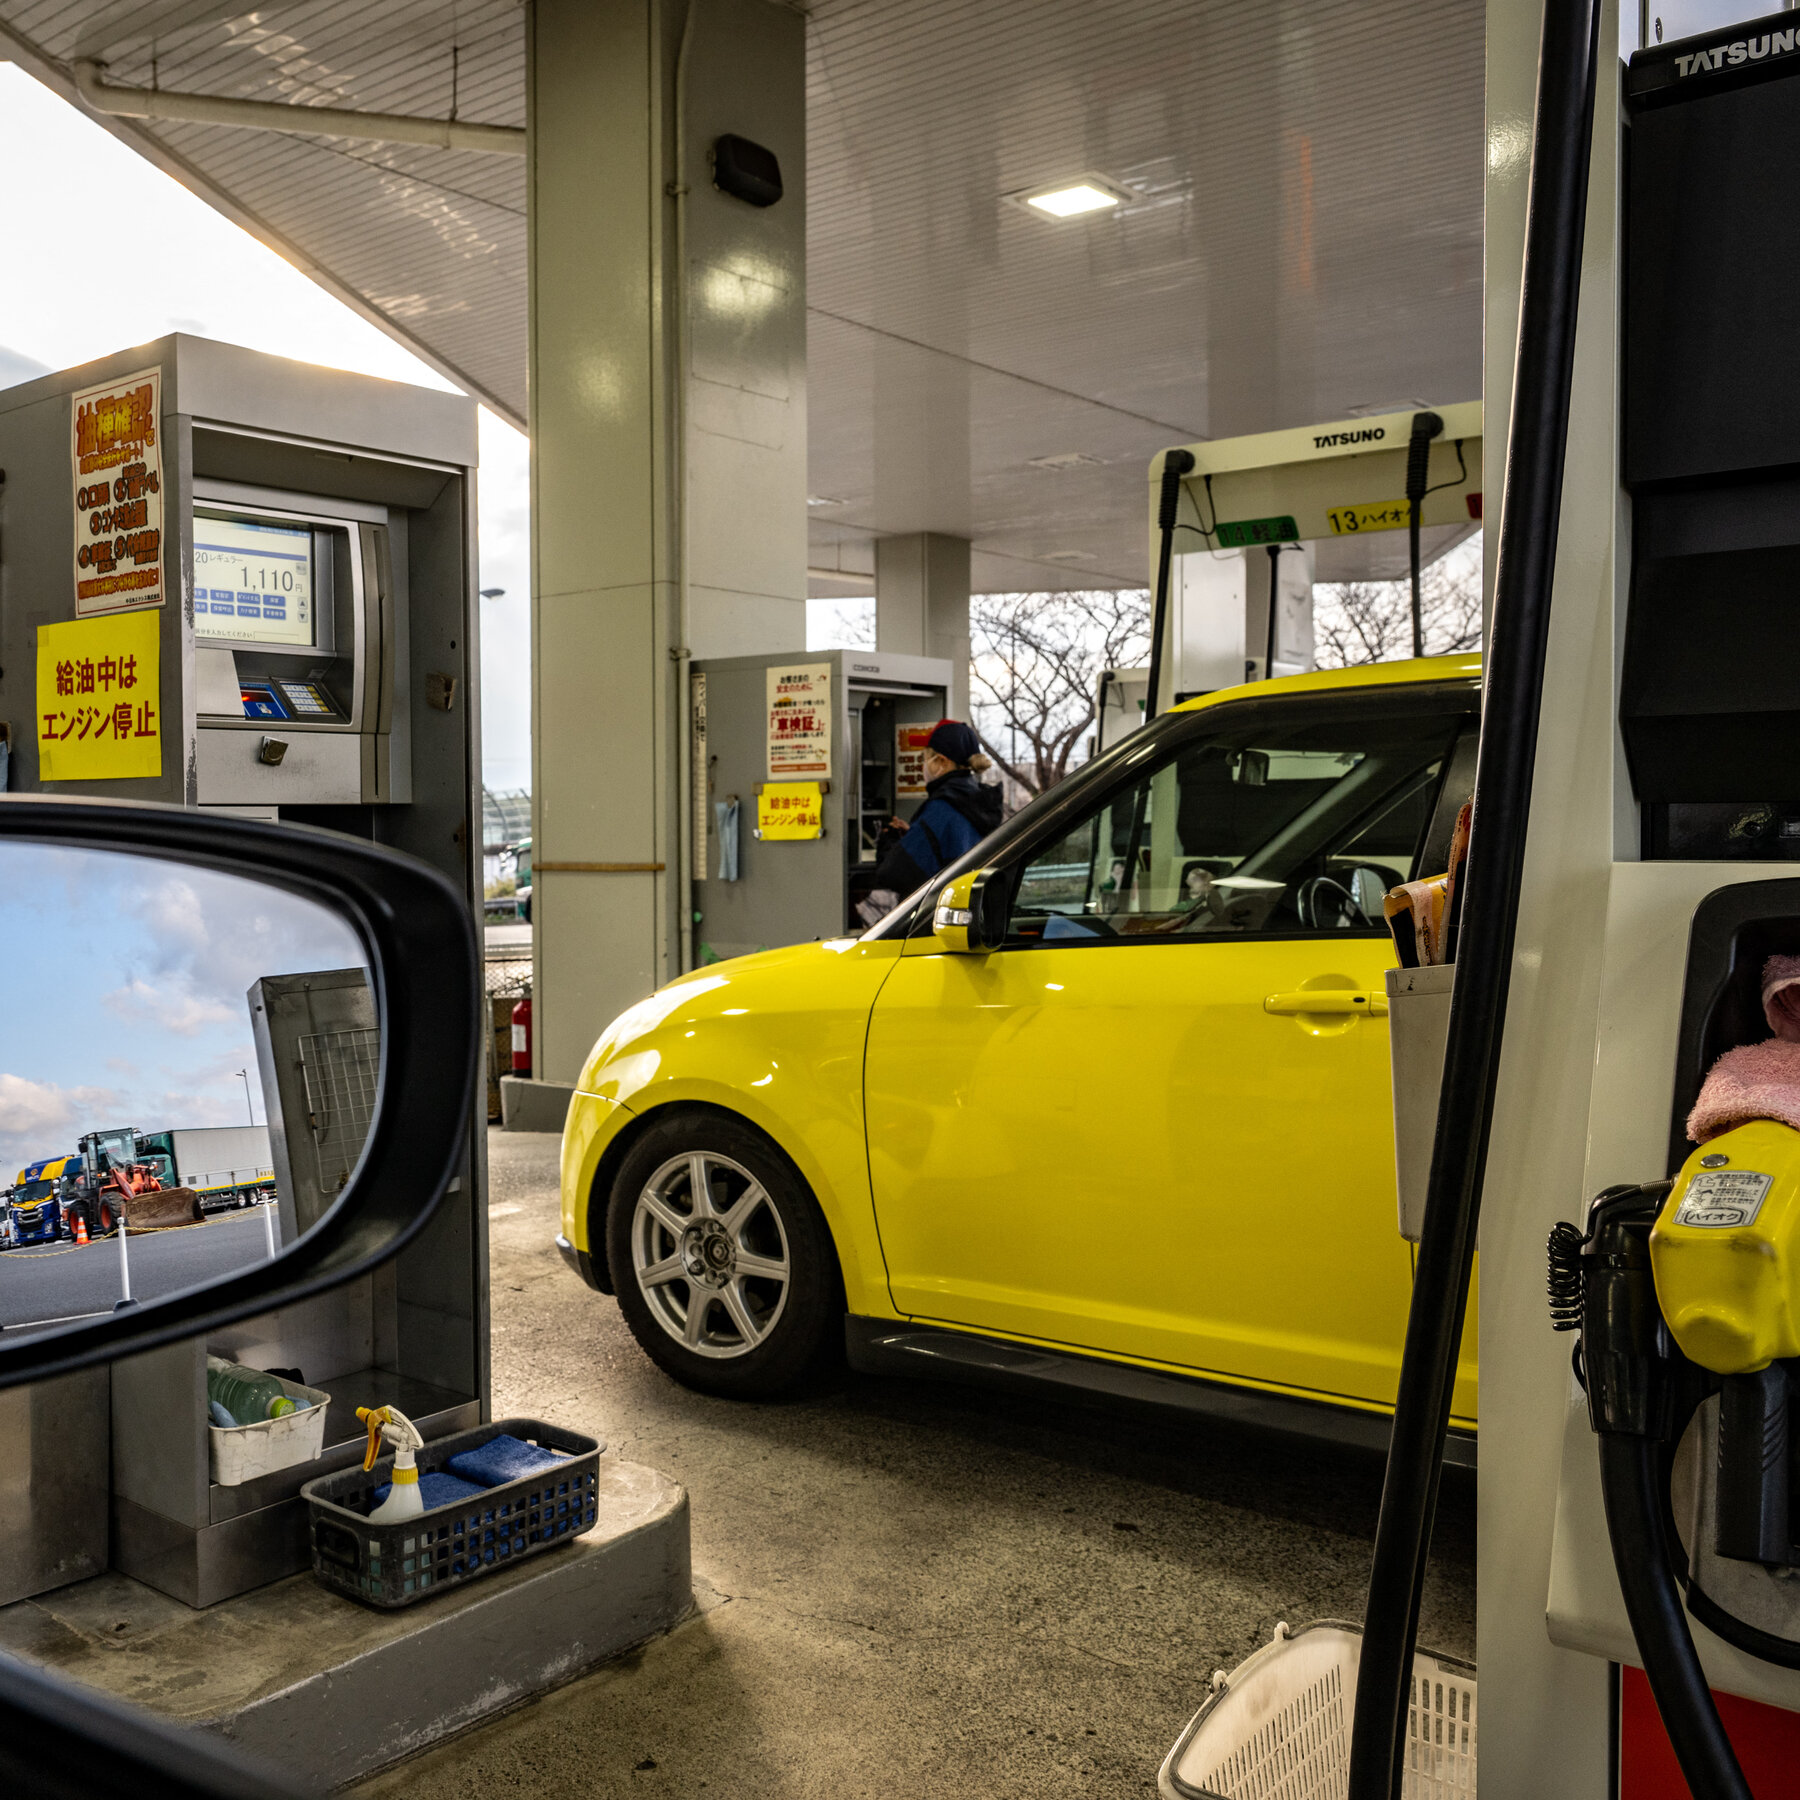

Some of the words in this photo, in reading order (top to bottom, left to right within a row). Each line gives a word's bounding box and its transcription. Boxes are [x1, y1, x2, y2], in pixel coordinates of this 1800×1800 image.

[1674, 28, 1800, 77] TATSUN
[1313, 427, 1385, 448] TATSUNO
[1329, 510, 1359, 533] 13
[1221, 525, 1246, 545] 14
[241, 566, 293, 592] 1,110
[56, 654, 138, 697] 給油中は
[41, 700, 157, 742] エンジン停止
[770, 796, 810, 810] 給油中は
[761, 812, 819, 826] エンジン停止
[1688, 1213, 1739, 1222] ハイオク
